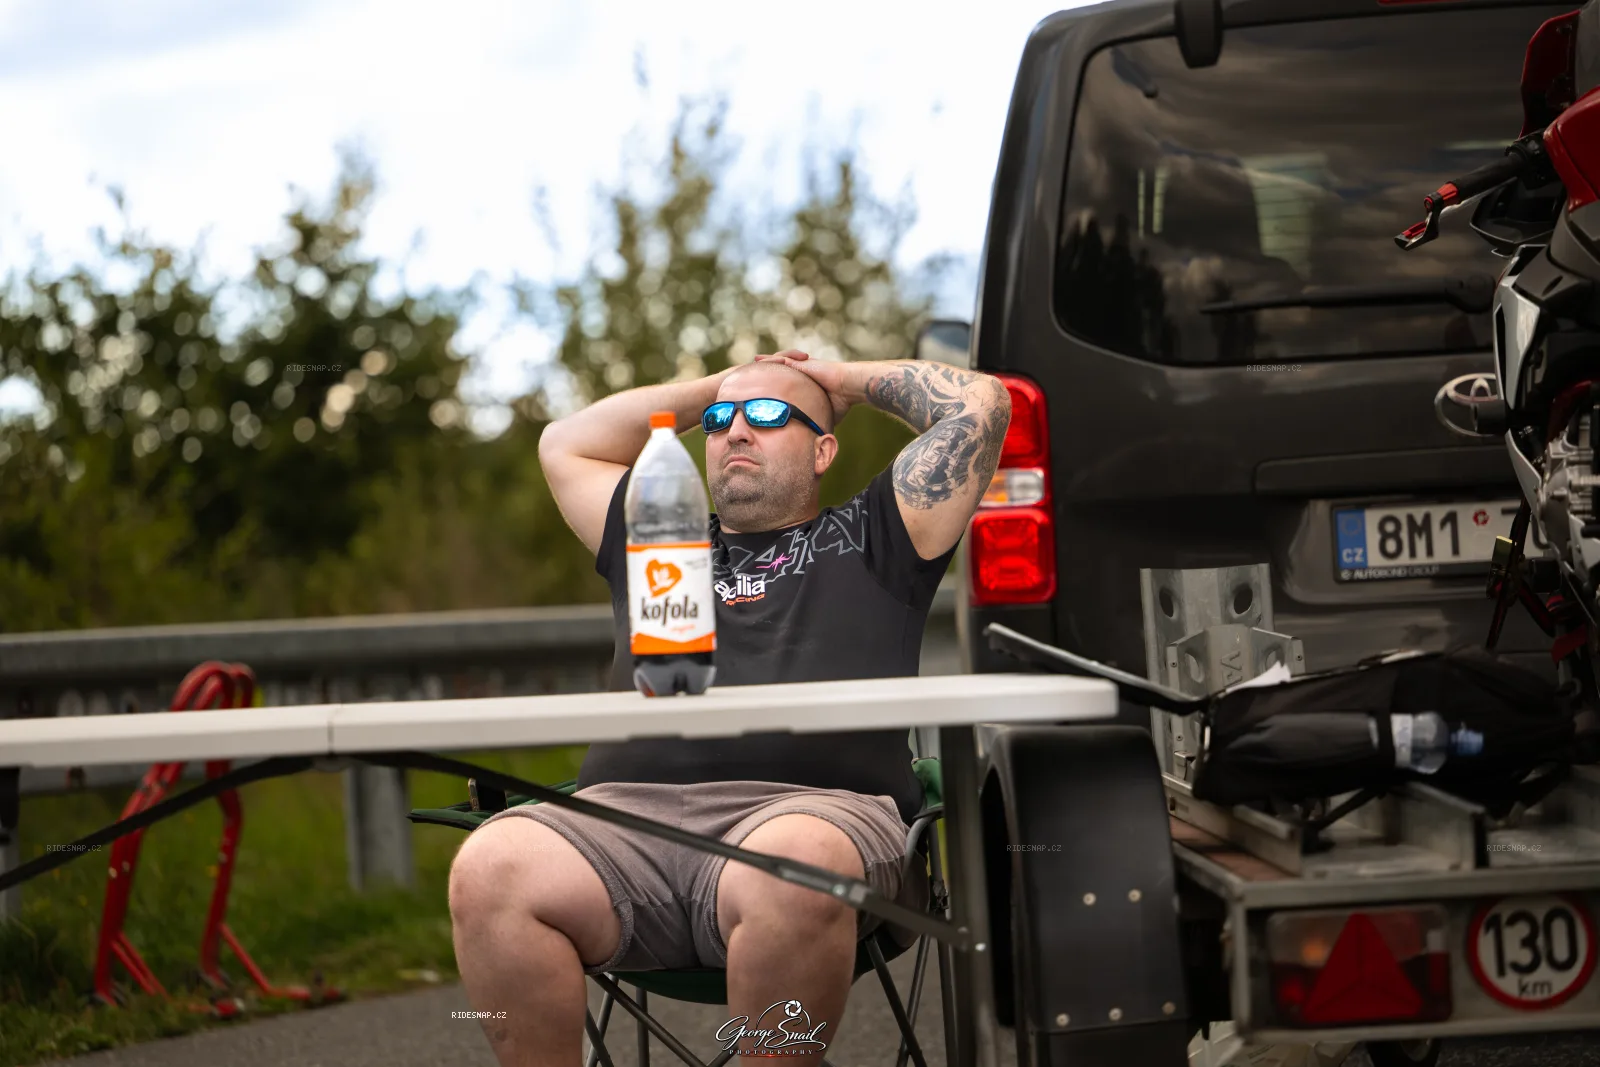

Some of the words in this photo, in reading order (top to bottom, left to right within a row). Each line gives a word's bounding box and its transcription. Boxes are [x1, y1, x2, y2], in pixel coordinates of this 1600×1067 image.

[1377, 510, 1461, 560] 8M1
[1342, 548, 1364, 564] CZ
[641, 595, 699, 625] kofola
[1483, 907, 1579, 978] 130
[1518, 979, 1553, 997] km
